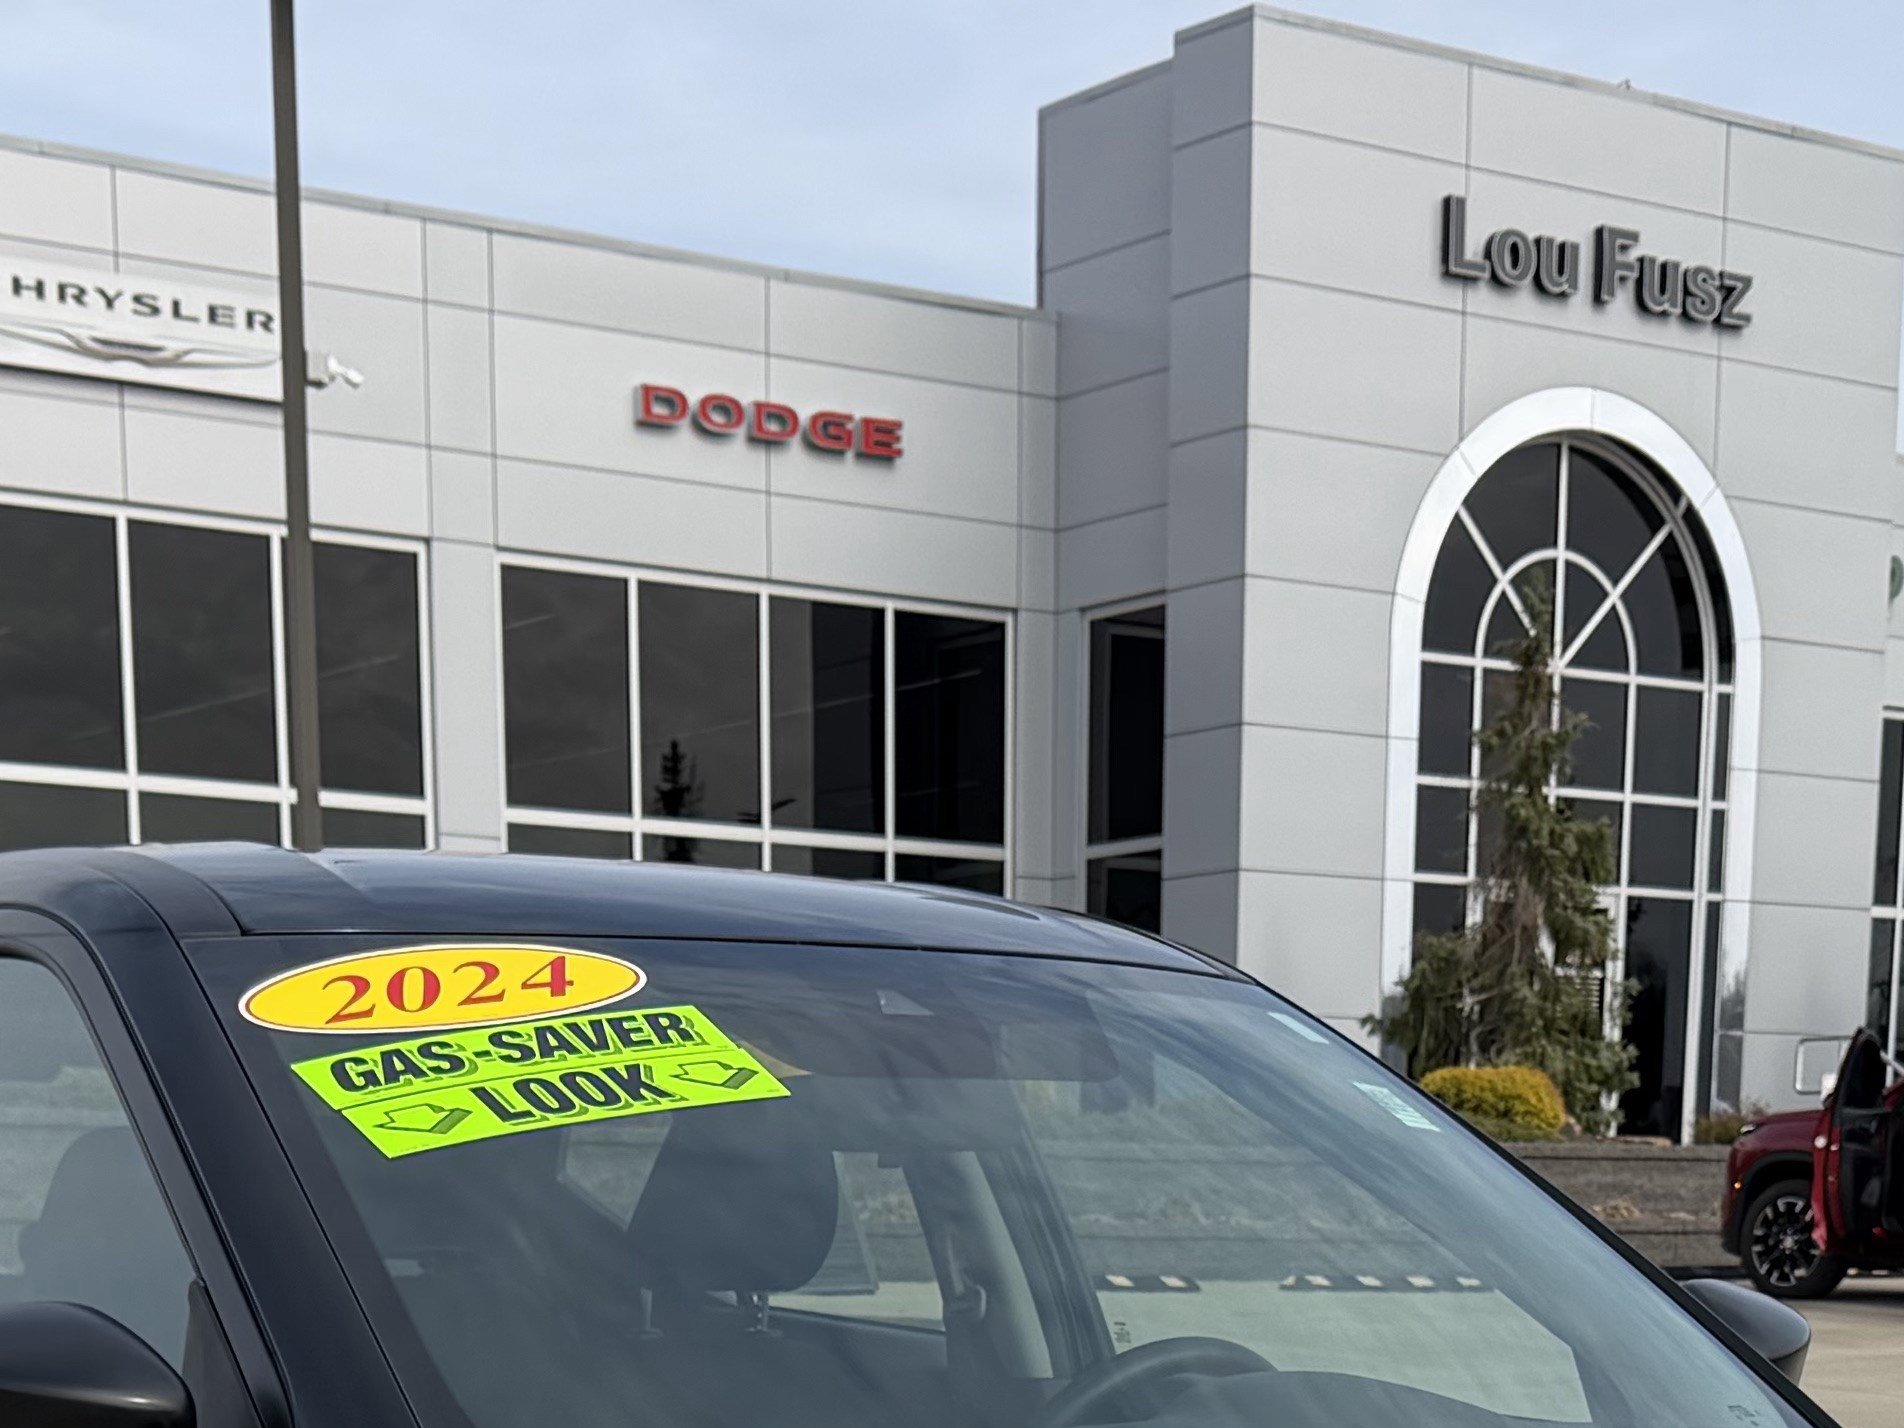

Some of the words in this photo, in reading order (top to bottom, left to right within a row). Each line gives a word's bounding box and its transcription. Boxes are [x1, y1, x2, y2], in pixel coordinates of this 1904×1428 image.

[1442, 194, 1580, 298] Lou
[1594, 224, 1753, 328] Fusz
[634, 384, 904, 459] DODGE
[322, 954, 575, 1024] 2024
[329, 1011, 699, 1094] GAS-SAVER
[472, 1063, 671, 1124] LOOK
